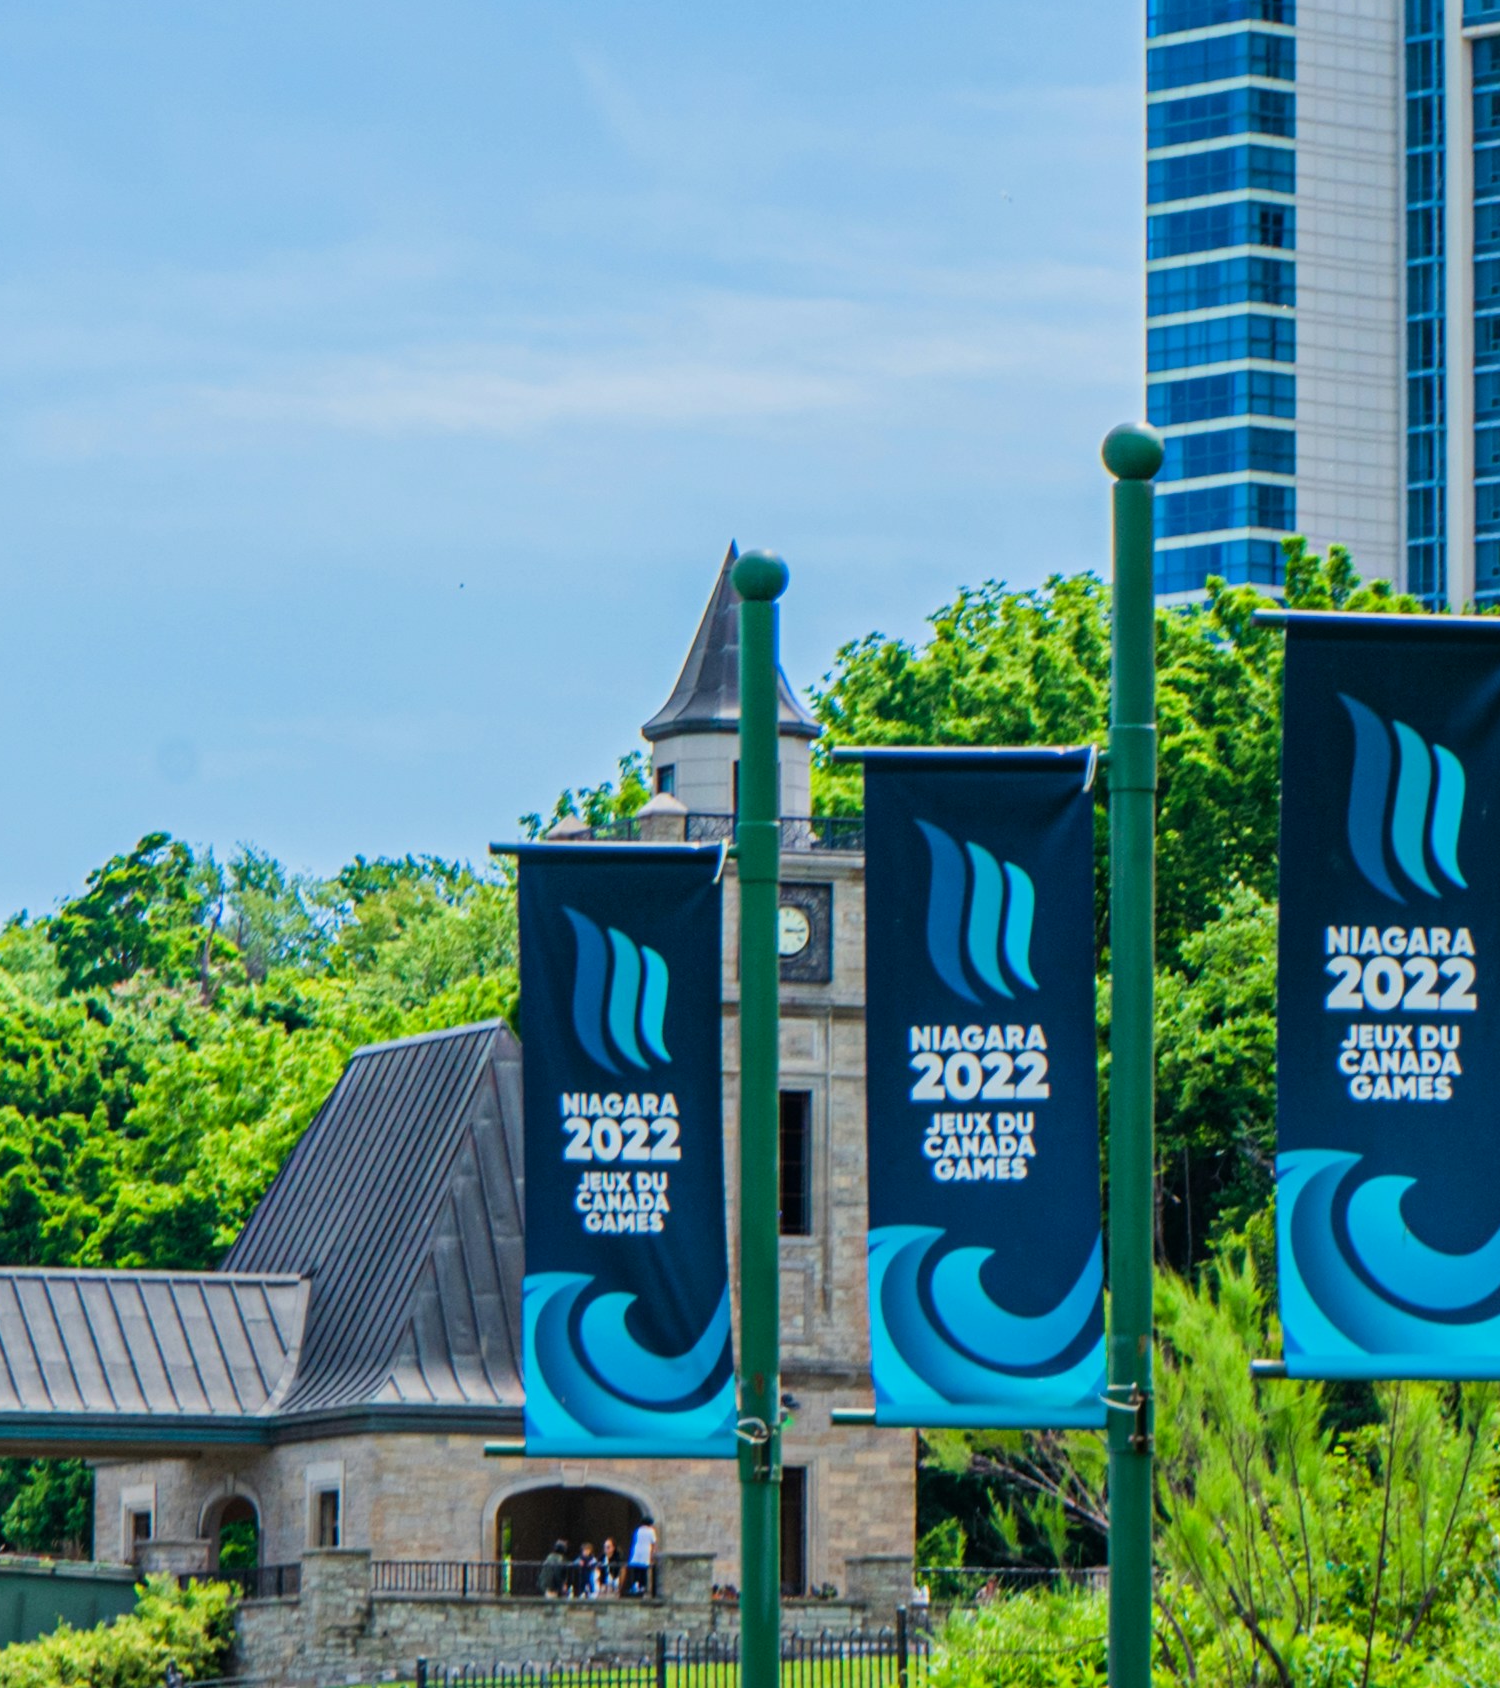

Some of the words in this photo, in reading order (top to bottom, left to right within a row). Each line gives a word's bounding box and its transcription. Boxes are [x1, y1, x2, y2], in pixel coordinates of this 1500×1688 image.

[1326, 925, 1476, 955] NIAGARA
[1325, 955, 1478, 1010] 2022
[909, 1024, 1048, 1051] NIAGARA
[1340, 1024, 1414, 1050] JEUX
[1419, 1024, 1461, 1050] DU
[1338, 1049, 1462, 1075] CANADA
[910, 1050, 1050, 1100] 2022
[1349, 1075, 1453, 1100] GAMES
[562, 1092, 680, 1116] NIAGARA
[925, 1111, 992, 1135] JEUX
[996, 1111, 1035, 1134] DU
[563, 1116, 682, 1161] 2022
[923, 1134, 1037, 1158] CANADA
[934, 1156, 1029, 1180] GAMES
[577, 1171, 632, 1192] JEUX
[636, 1171, 669, 1192] DU
[575, 1191, 671, 1212] CANADA
[584, 1211, 665, 1232] GAMES
